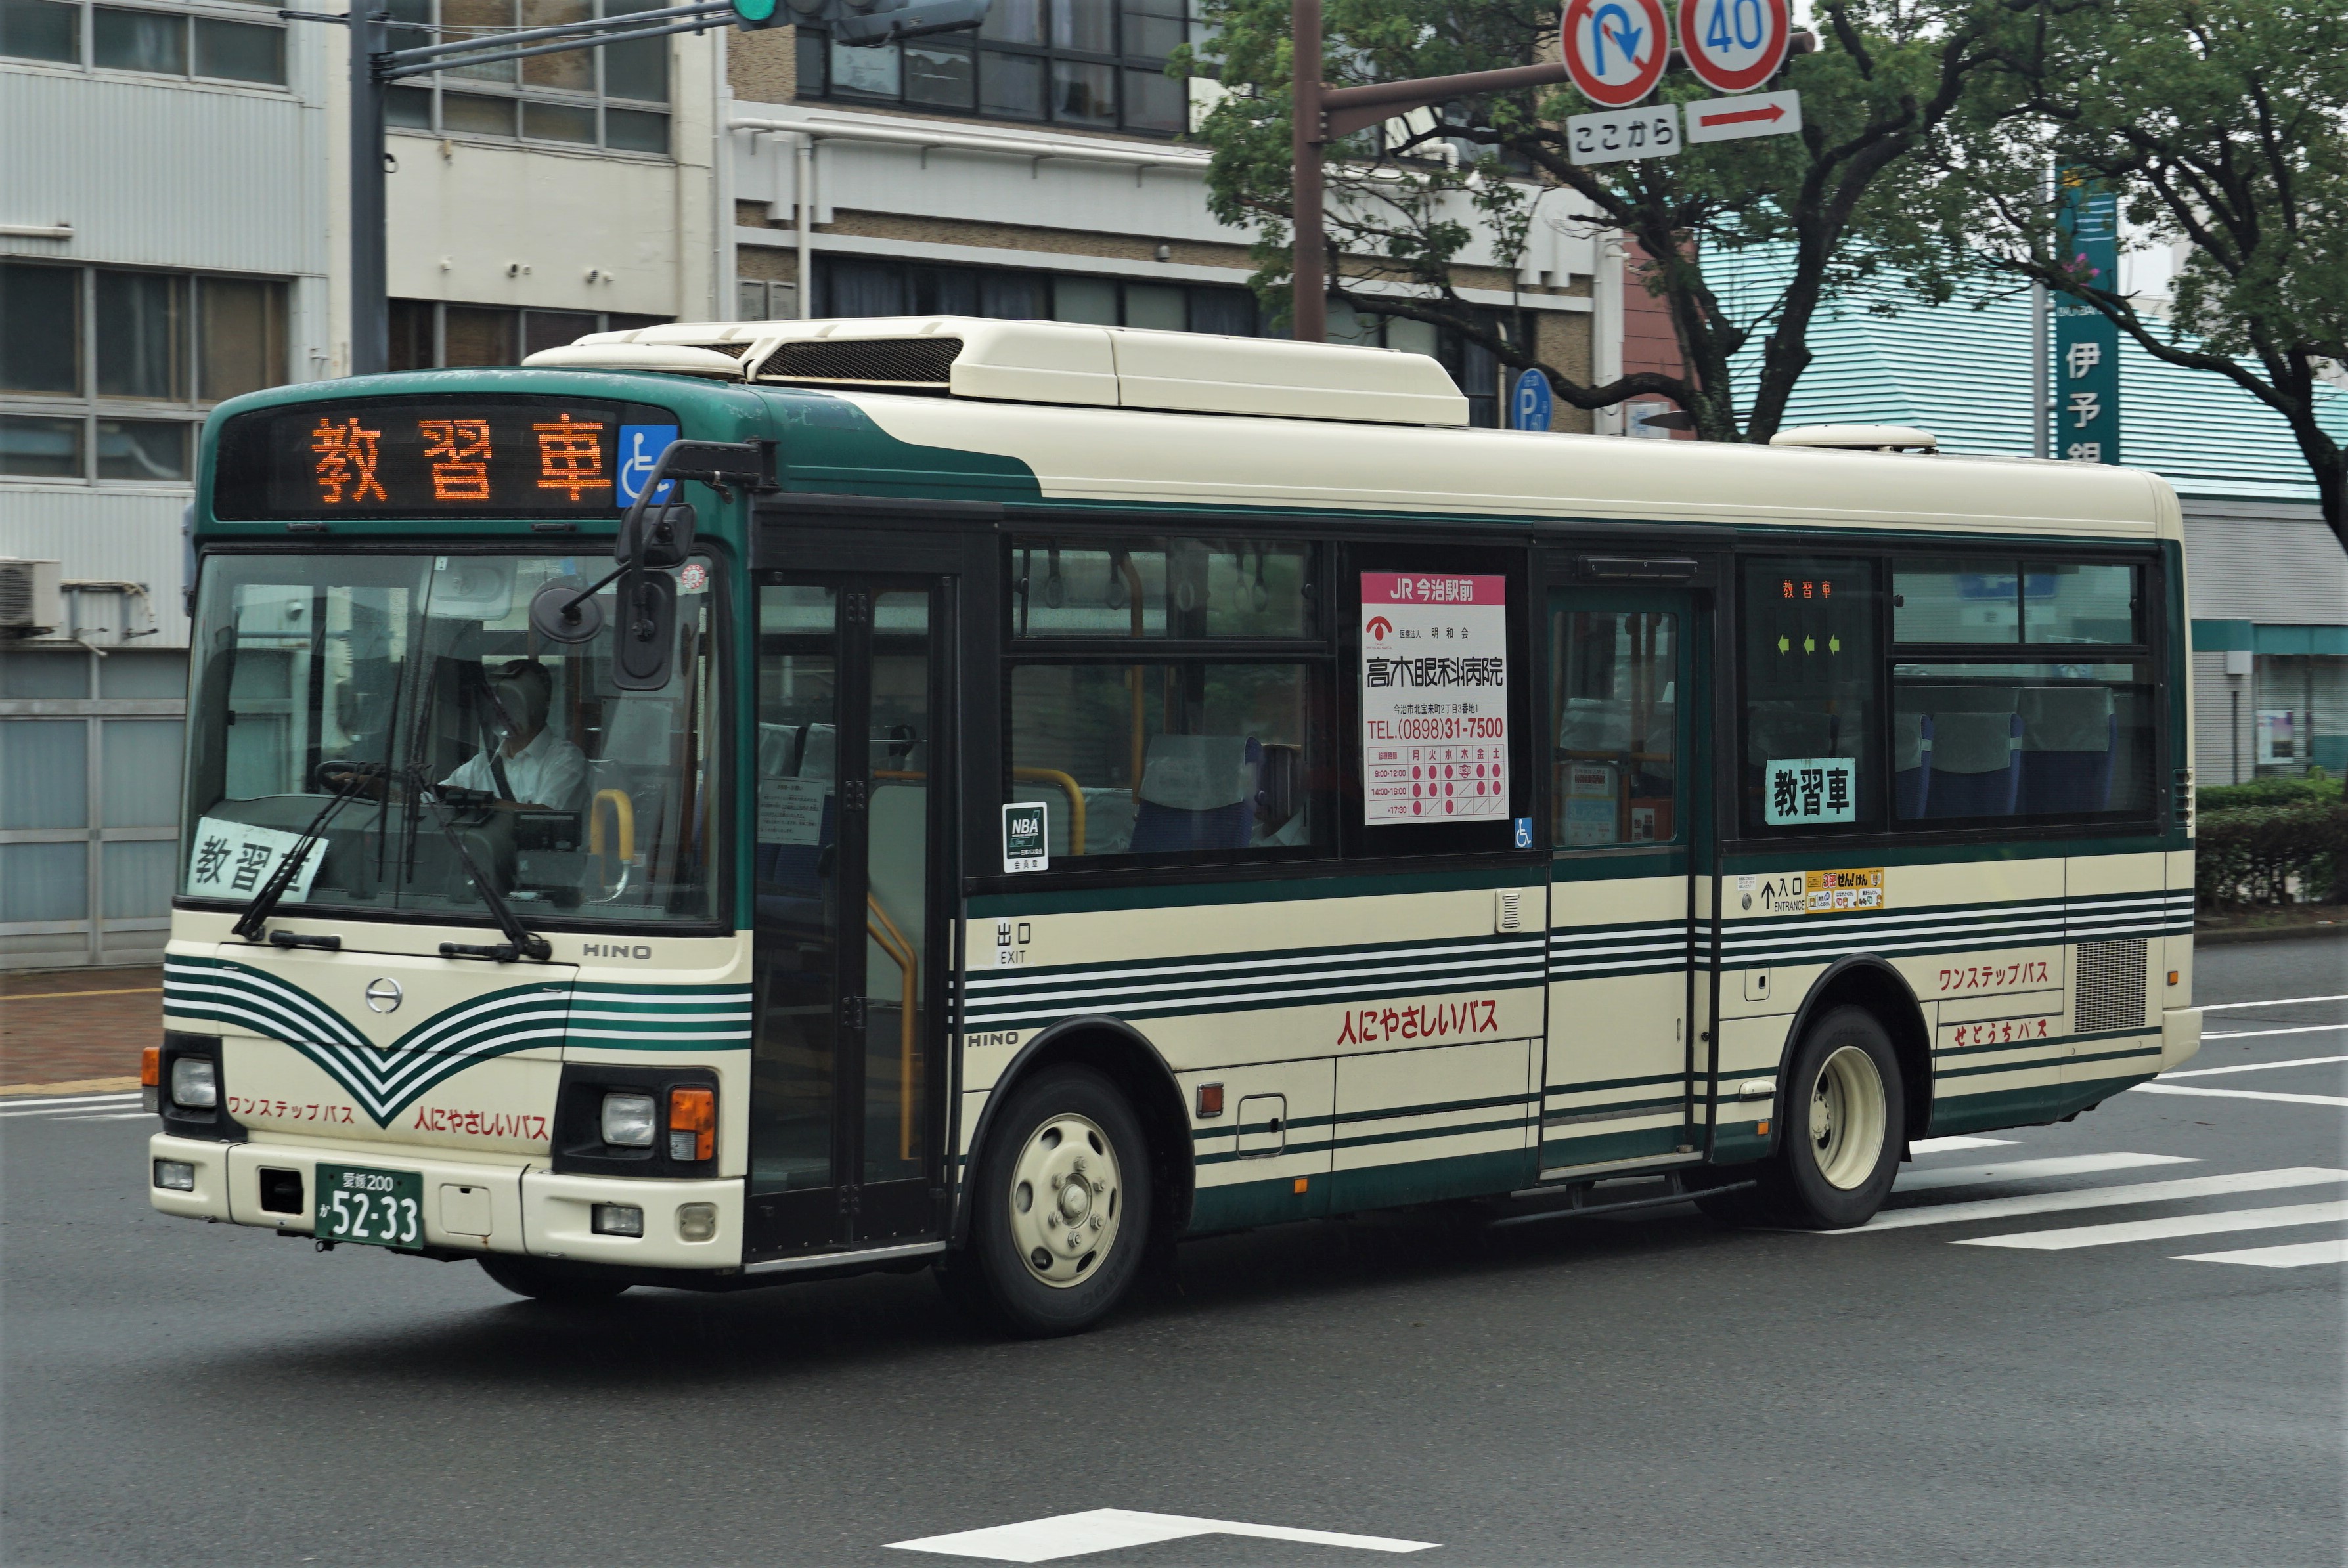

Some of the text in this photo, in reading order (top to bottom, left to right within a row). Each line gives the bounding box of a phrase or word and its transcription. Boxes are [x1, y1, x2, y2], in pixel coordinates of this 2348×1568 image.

[1707, 0, 1763, 53] 40
[1576, 118, 1673, 153] ここから
[311, 412, 612, 504] 教習車
[1390, 578, 1473, 601] JR 今治駅前
[1783, 580, 1832, 599] 教習車
[1400, 627, 1469, 639] 医療法人 明和会
[1367, 655, 1503, 688] 高木眼科病院
[1413, 749, 1420, 761] 月
[1429, 749, 1436, 761] 火
[1445, 749, 1453, 760] 水
[1461, 748, 1469, 760] 木
[1476, 748, 1484, 760] 金
[1492, 747, 1500, 759] 土
[1773, 766, 1850, 817] 教習車
[1011, 818, 1039, 834] NBA
[1778, 877, 1802, 898] 入口
[1774, 900, 1805, 912] ENTRANCE
[997, 922, 1031, 947] 出口
[582, 944, 652, 960] HINO
[1000, 950, 1026, 965] EXIT
[1939, 961, 2049, 991] ワンステップバス
[1337, 999, 1498, 1045] 人にやさしいバス
[1955, 1018, 2047, 1047] せとうちバス
[968, 1031, 1019, 1048] HINO
[227, 1097, 355, 1125] ワンステップバス
[413, 1105, 550, 1141] 人にやさしいバス
